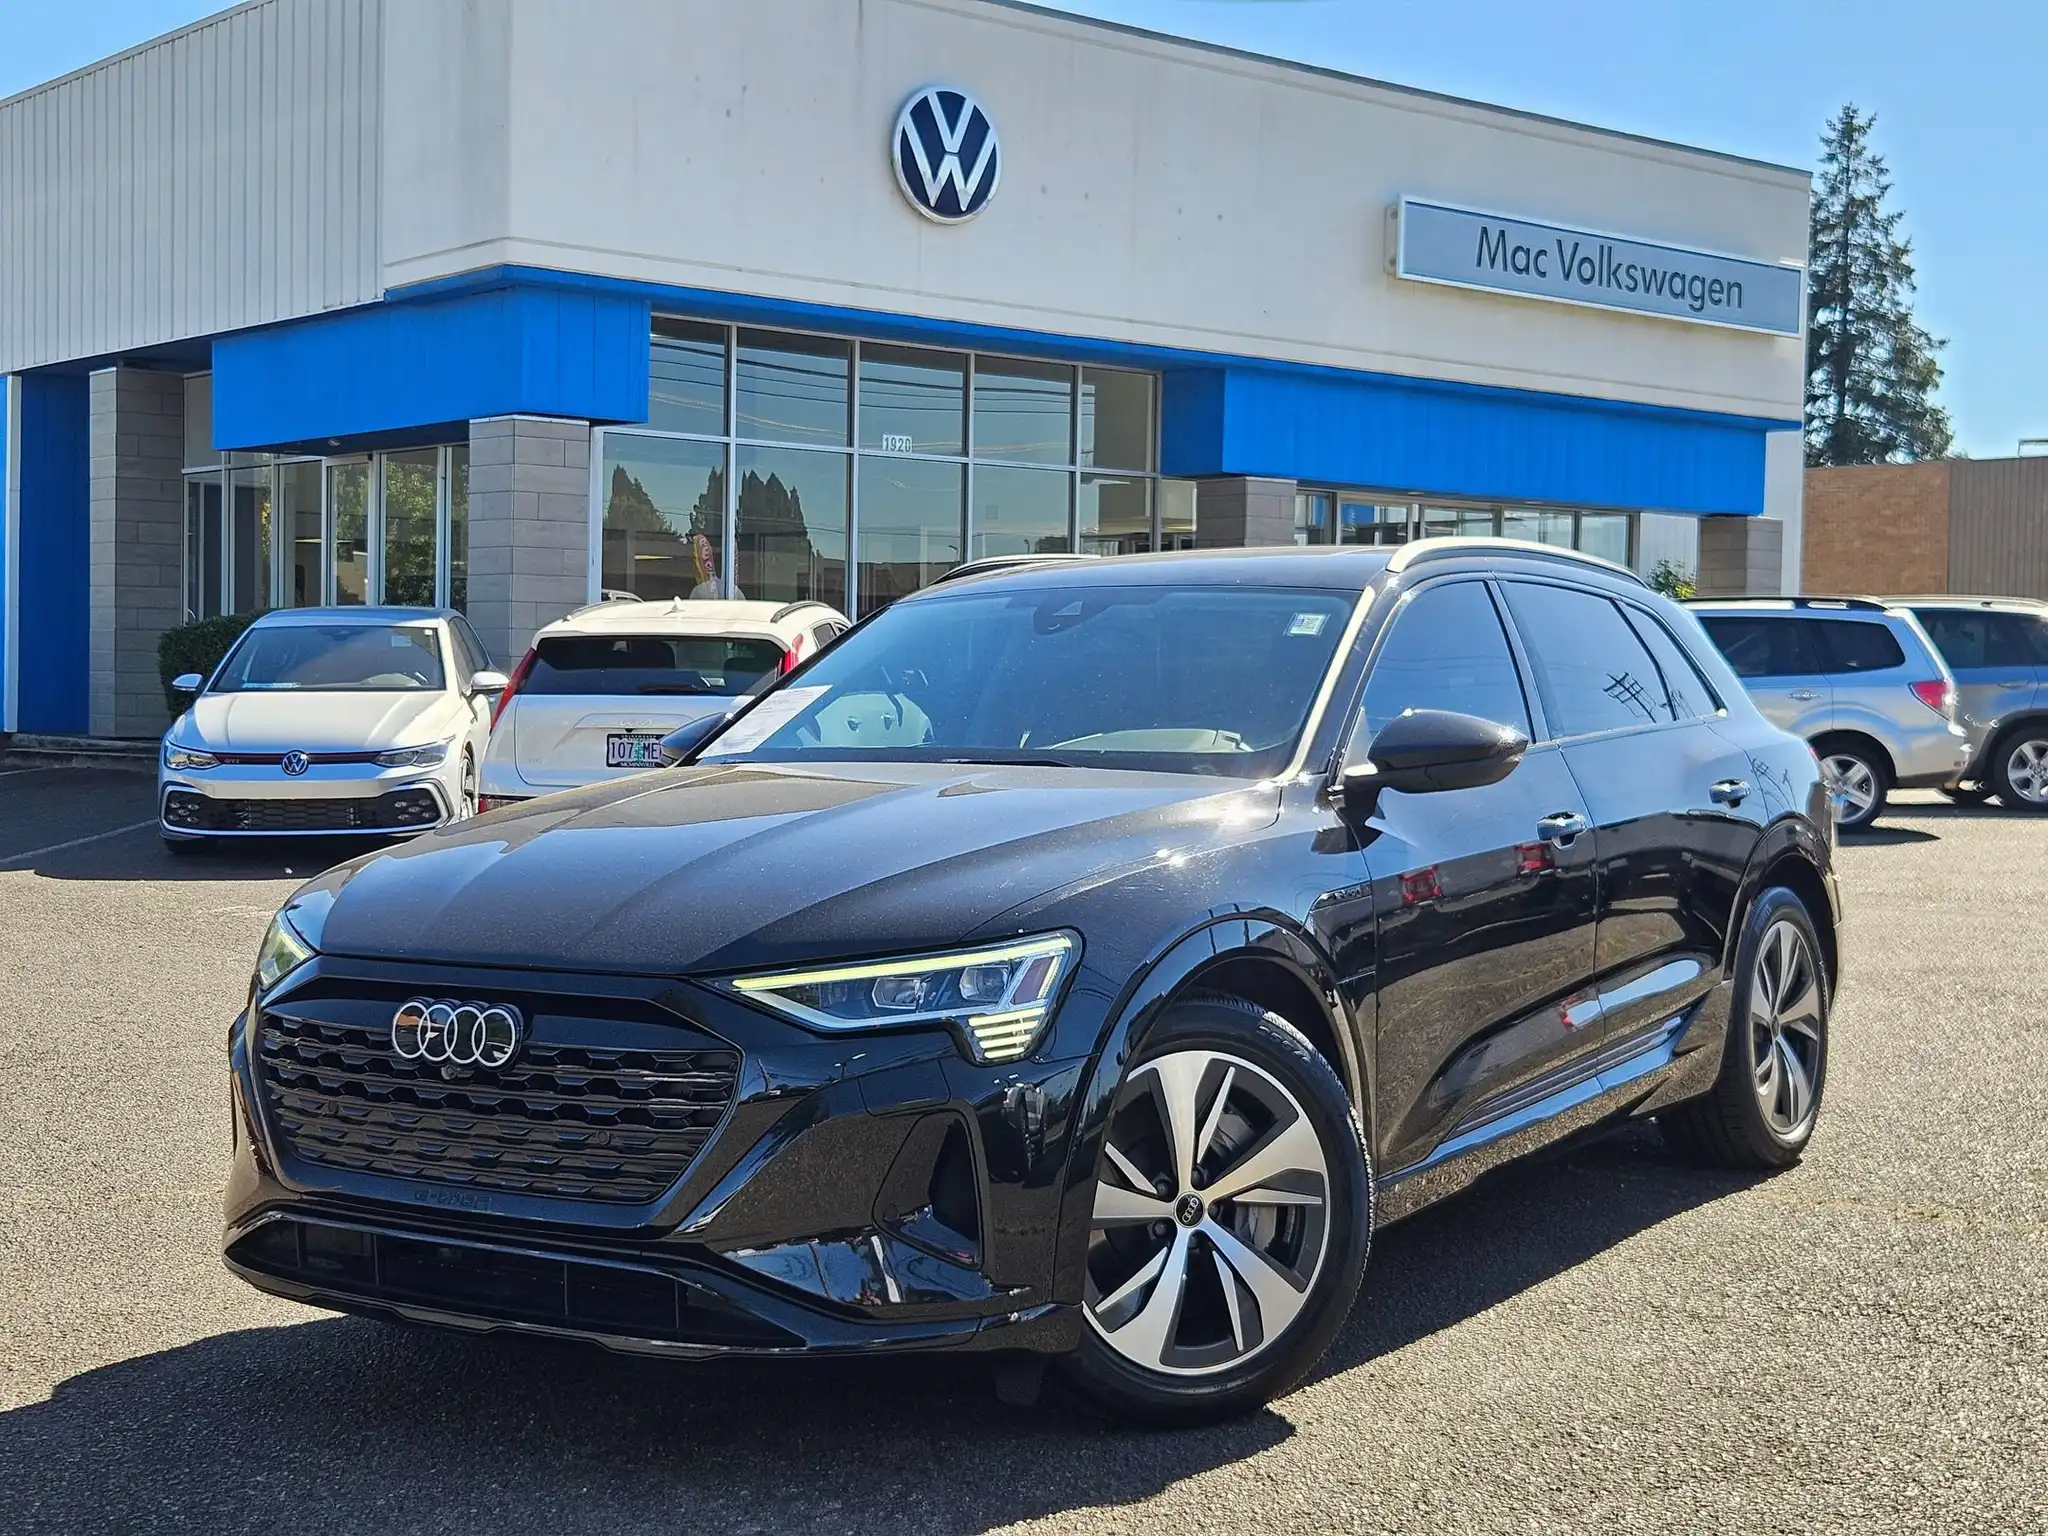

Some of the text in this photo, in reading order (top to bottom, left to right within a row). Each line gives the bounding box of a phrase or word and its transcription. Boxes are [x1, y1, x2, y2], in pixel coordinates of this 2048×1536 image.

[1476, 226, 1743, 313] Mac Volkswagen
[884, 436, 911, 452] 1920
[611, 741, 662, 760] 107 ME
